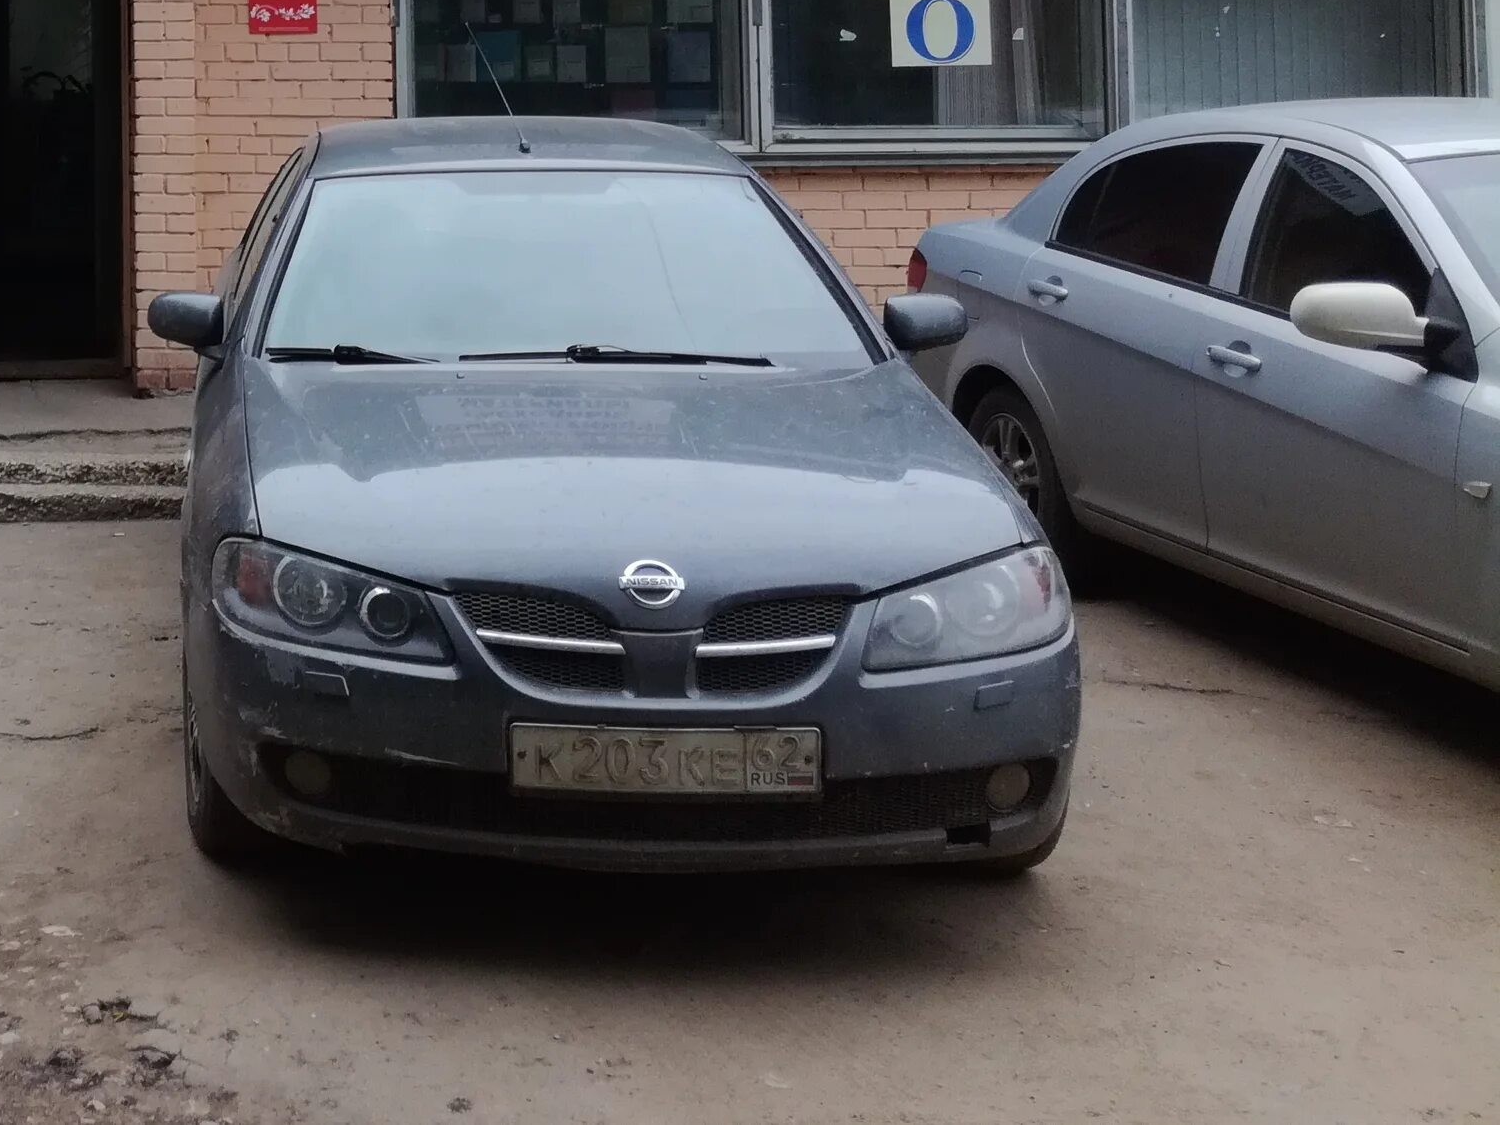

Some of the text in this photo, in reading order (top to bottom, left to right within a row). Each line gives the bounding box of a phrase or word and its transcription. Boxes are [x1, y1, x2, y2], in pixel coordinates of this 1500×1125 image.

[626, 578, 678, 586] NISSAN
[751, 736, 801, 771] 62
[751, 773, 786, 786] RUS
